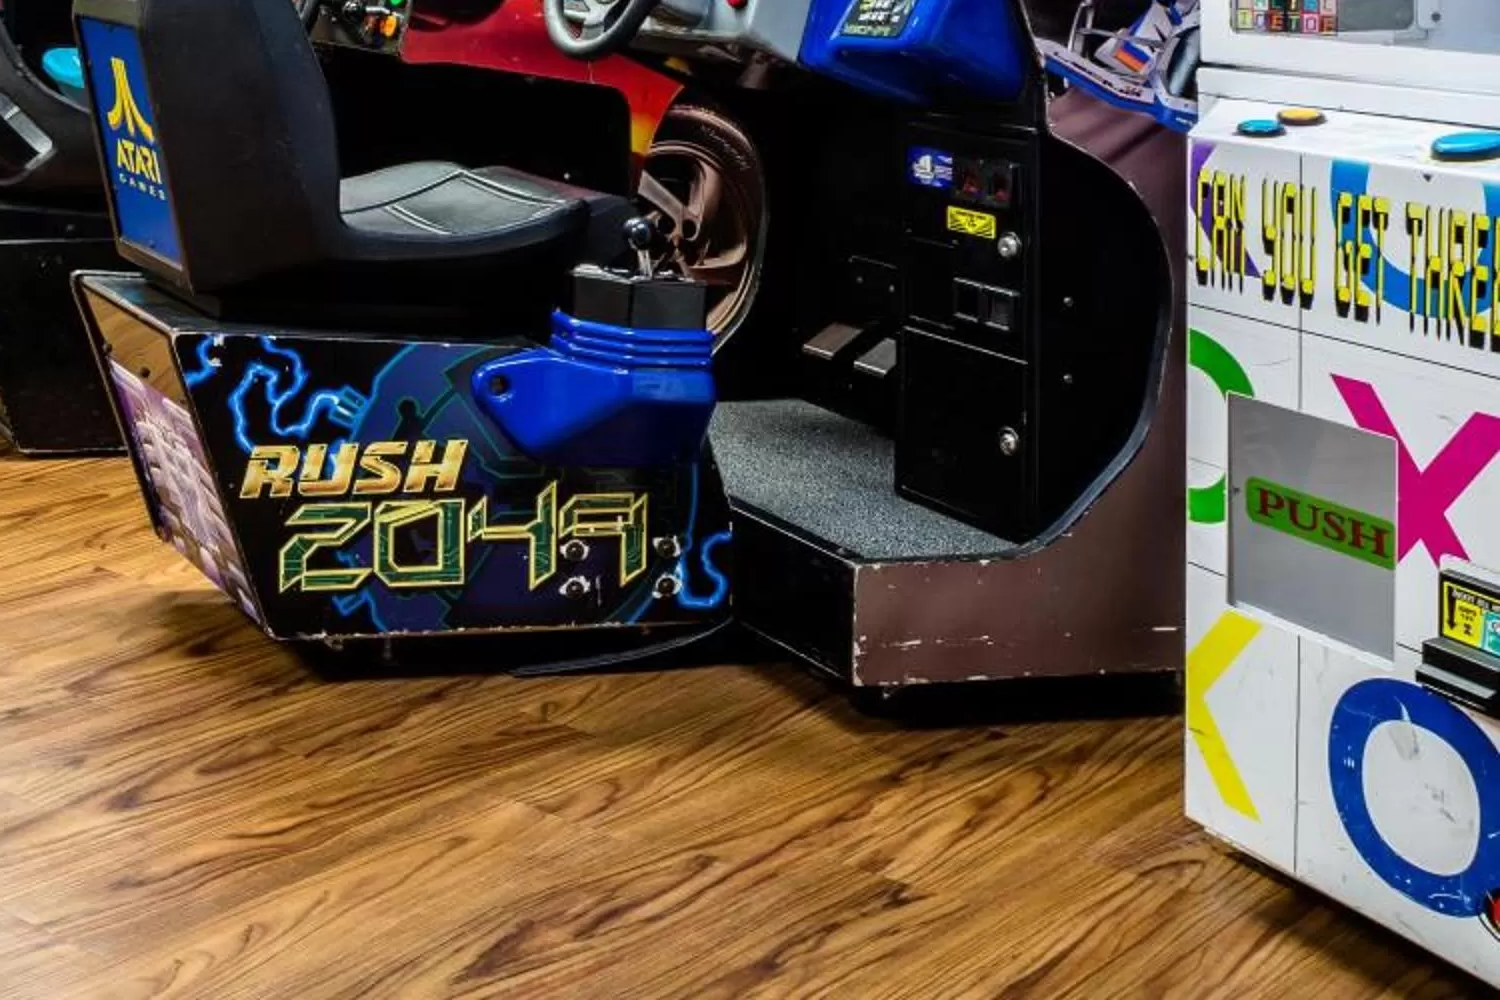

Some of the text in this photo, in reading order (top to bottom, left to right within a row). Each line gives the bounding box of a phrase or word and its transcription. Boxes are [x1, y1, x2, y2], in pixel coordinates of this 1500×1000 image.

[117, 138, 162, 185] ATARI
[119, 172, 166, 201] GAMES
[1196, 168, 1246, 294] CAN
[1262, 178, 1316, 309] YOU
[1335, 192, 1390, 324] GET
[240, 439, 468, 498] RUSH
[279, 480, 648, 593] 2049
[1258, 487, 1392, 558] PUSH
